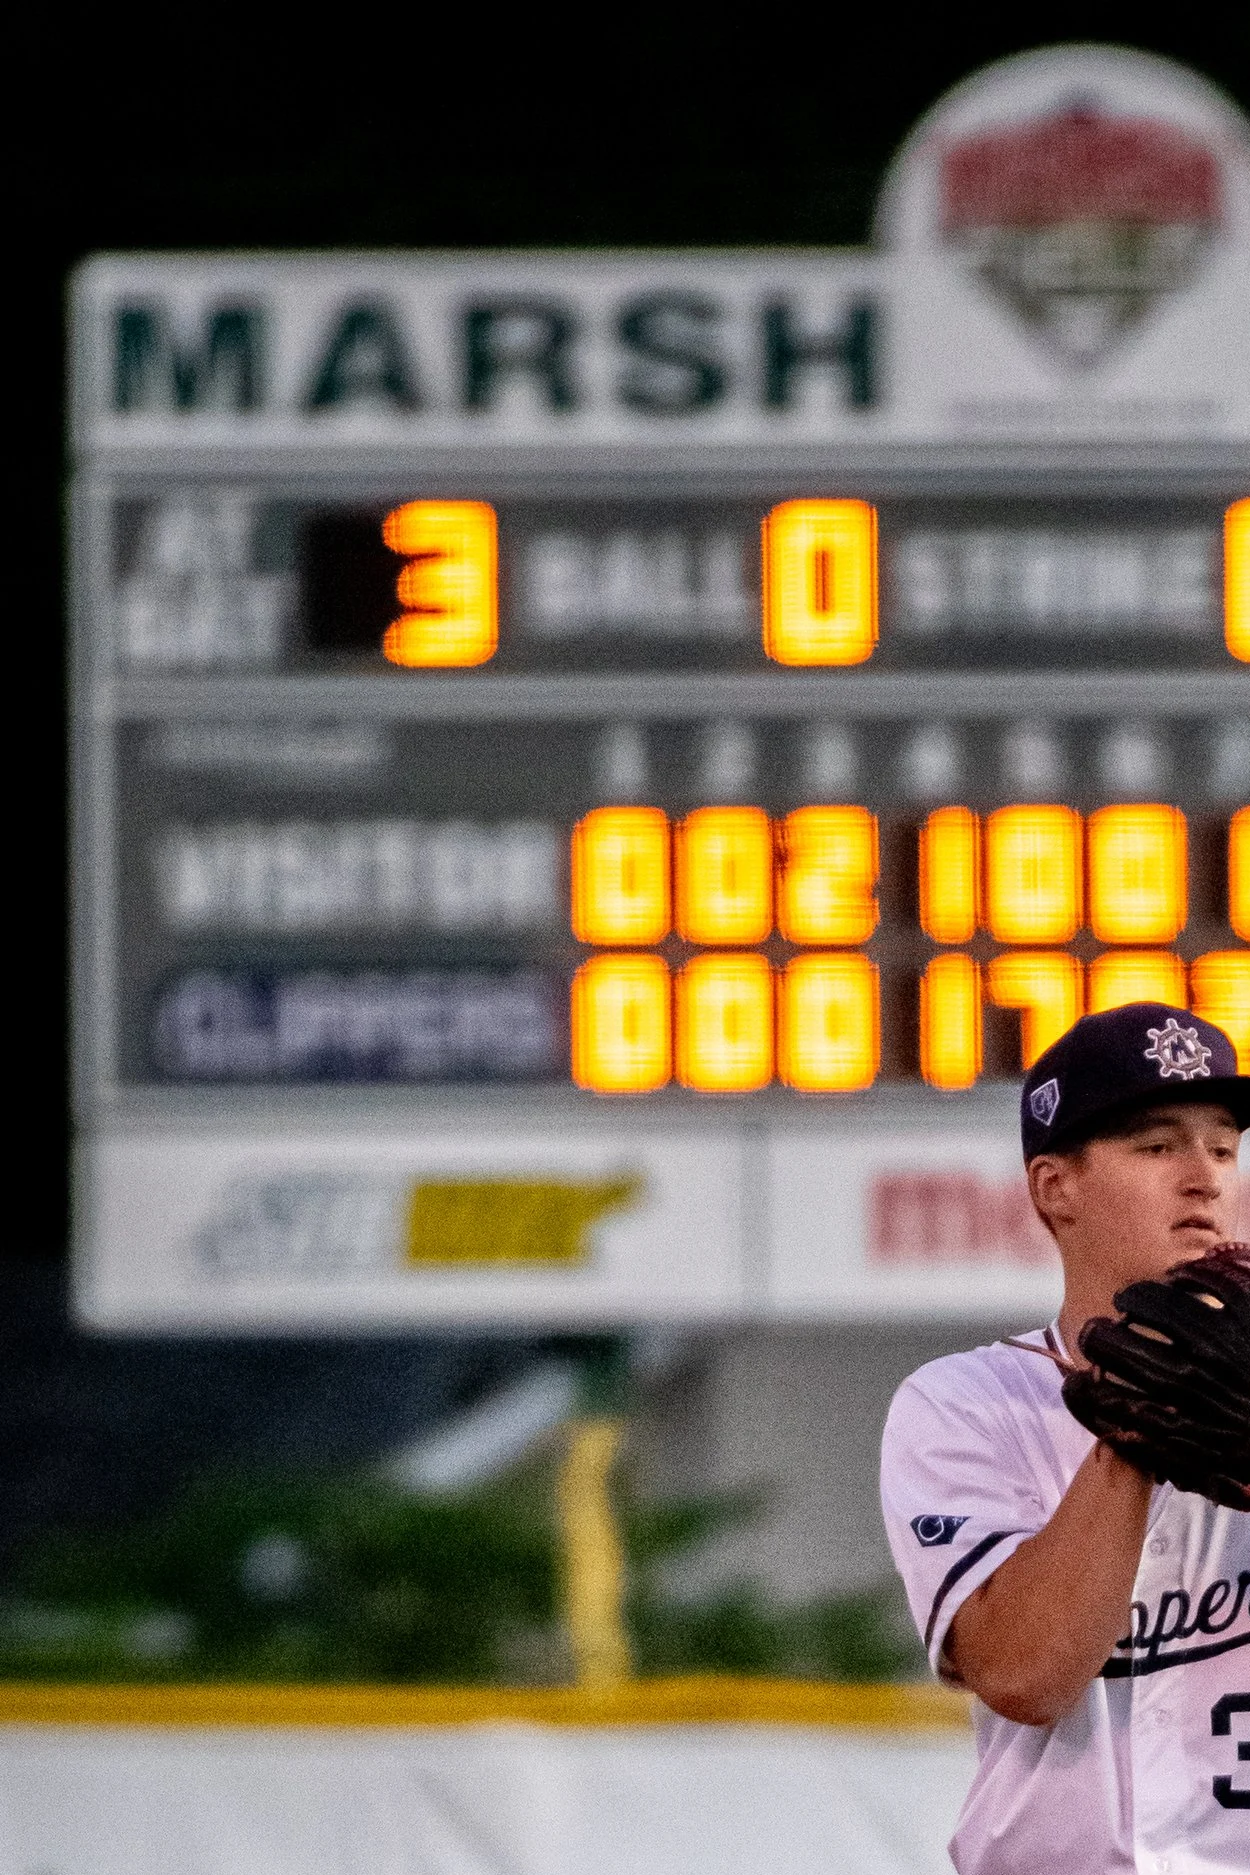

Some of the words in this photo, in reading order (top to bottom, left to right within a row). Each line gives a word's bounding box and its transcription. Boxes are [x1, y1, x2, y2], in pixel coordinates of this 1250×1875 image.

[113, 288, 881, 415] MARSH
[384, 500, 498, 667] 3
[762, 499, 879, 666] 0
